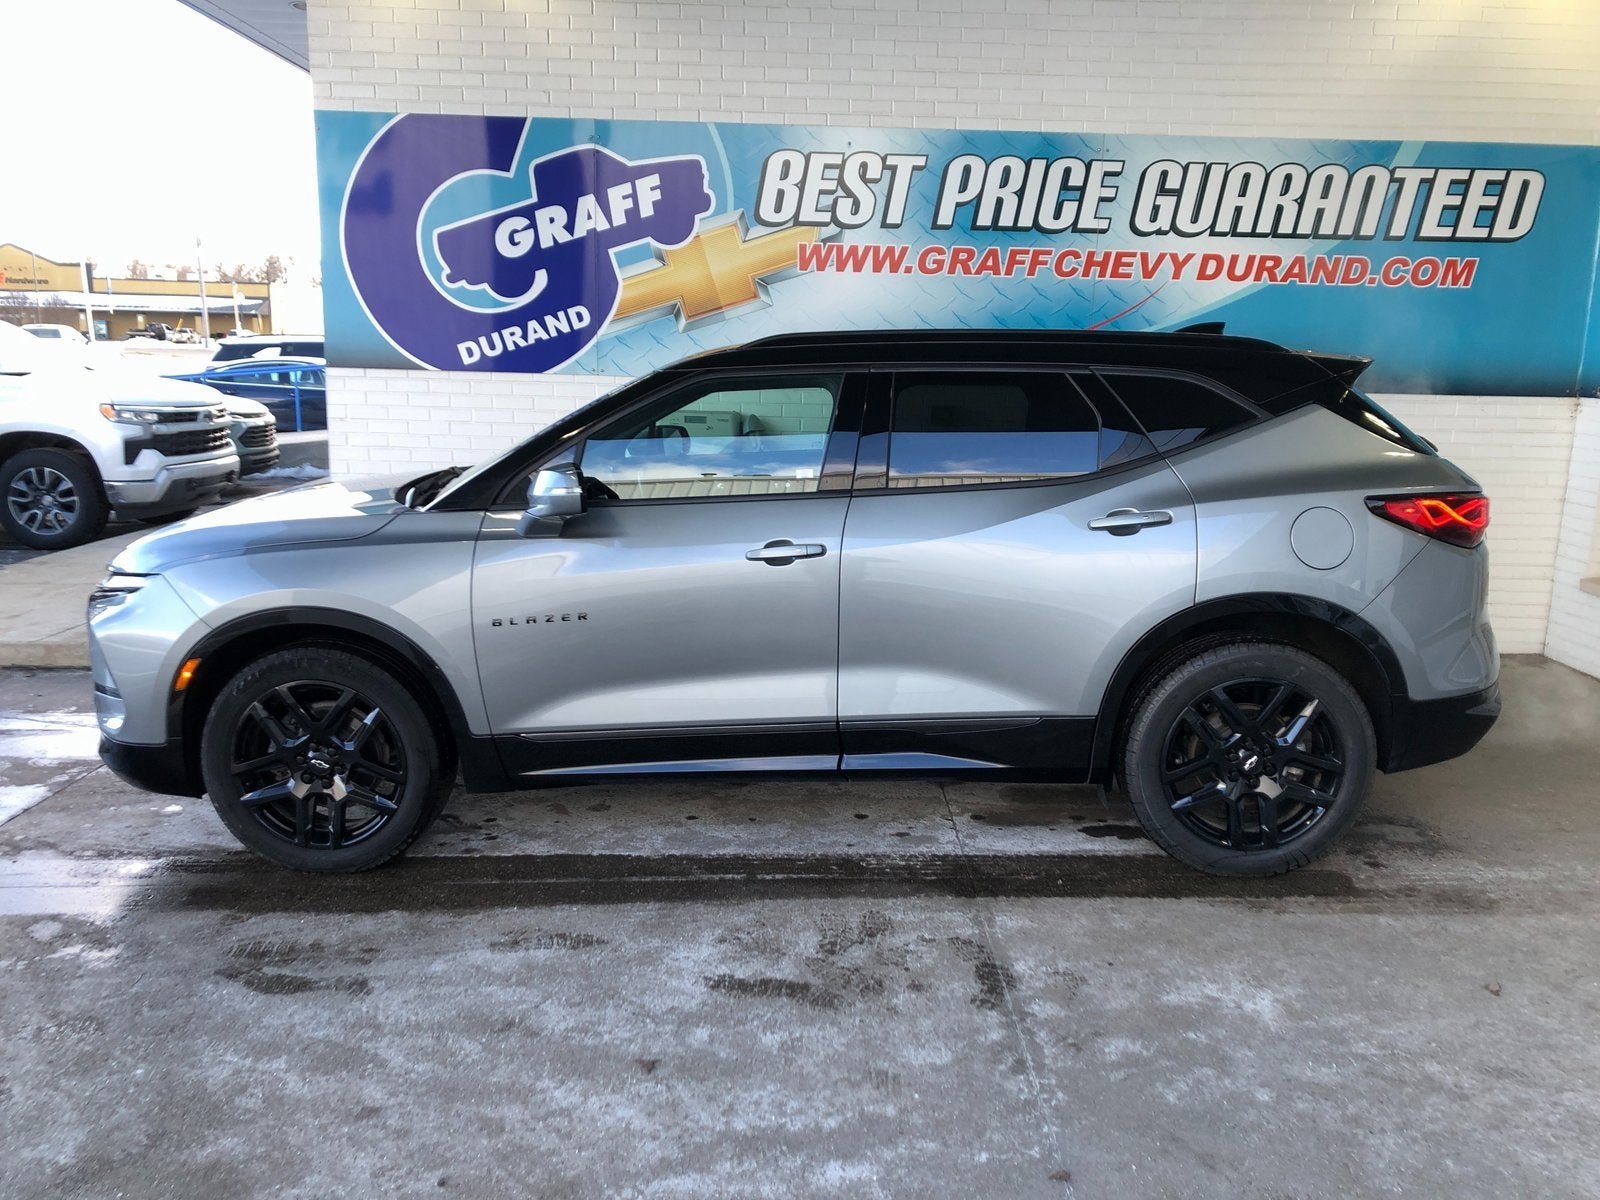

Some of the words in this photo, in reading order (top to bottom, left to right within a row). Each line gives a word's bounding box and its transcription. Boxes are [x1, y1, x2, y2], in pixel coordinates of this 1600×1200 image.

[495, 173, 662, 258] GRAFF
[755, 149, 929, 230] BEST
[933, 154, 1125, 234] PRICE
[1129, 159, 1546, 243] GUARANTEED
[797, 242, 1480, 288] WWW.GRAFFCHEVYDURAND.COM
[456, 304, 592, 366] DURAND
[491, 612, 589, 627] BLAZER
